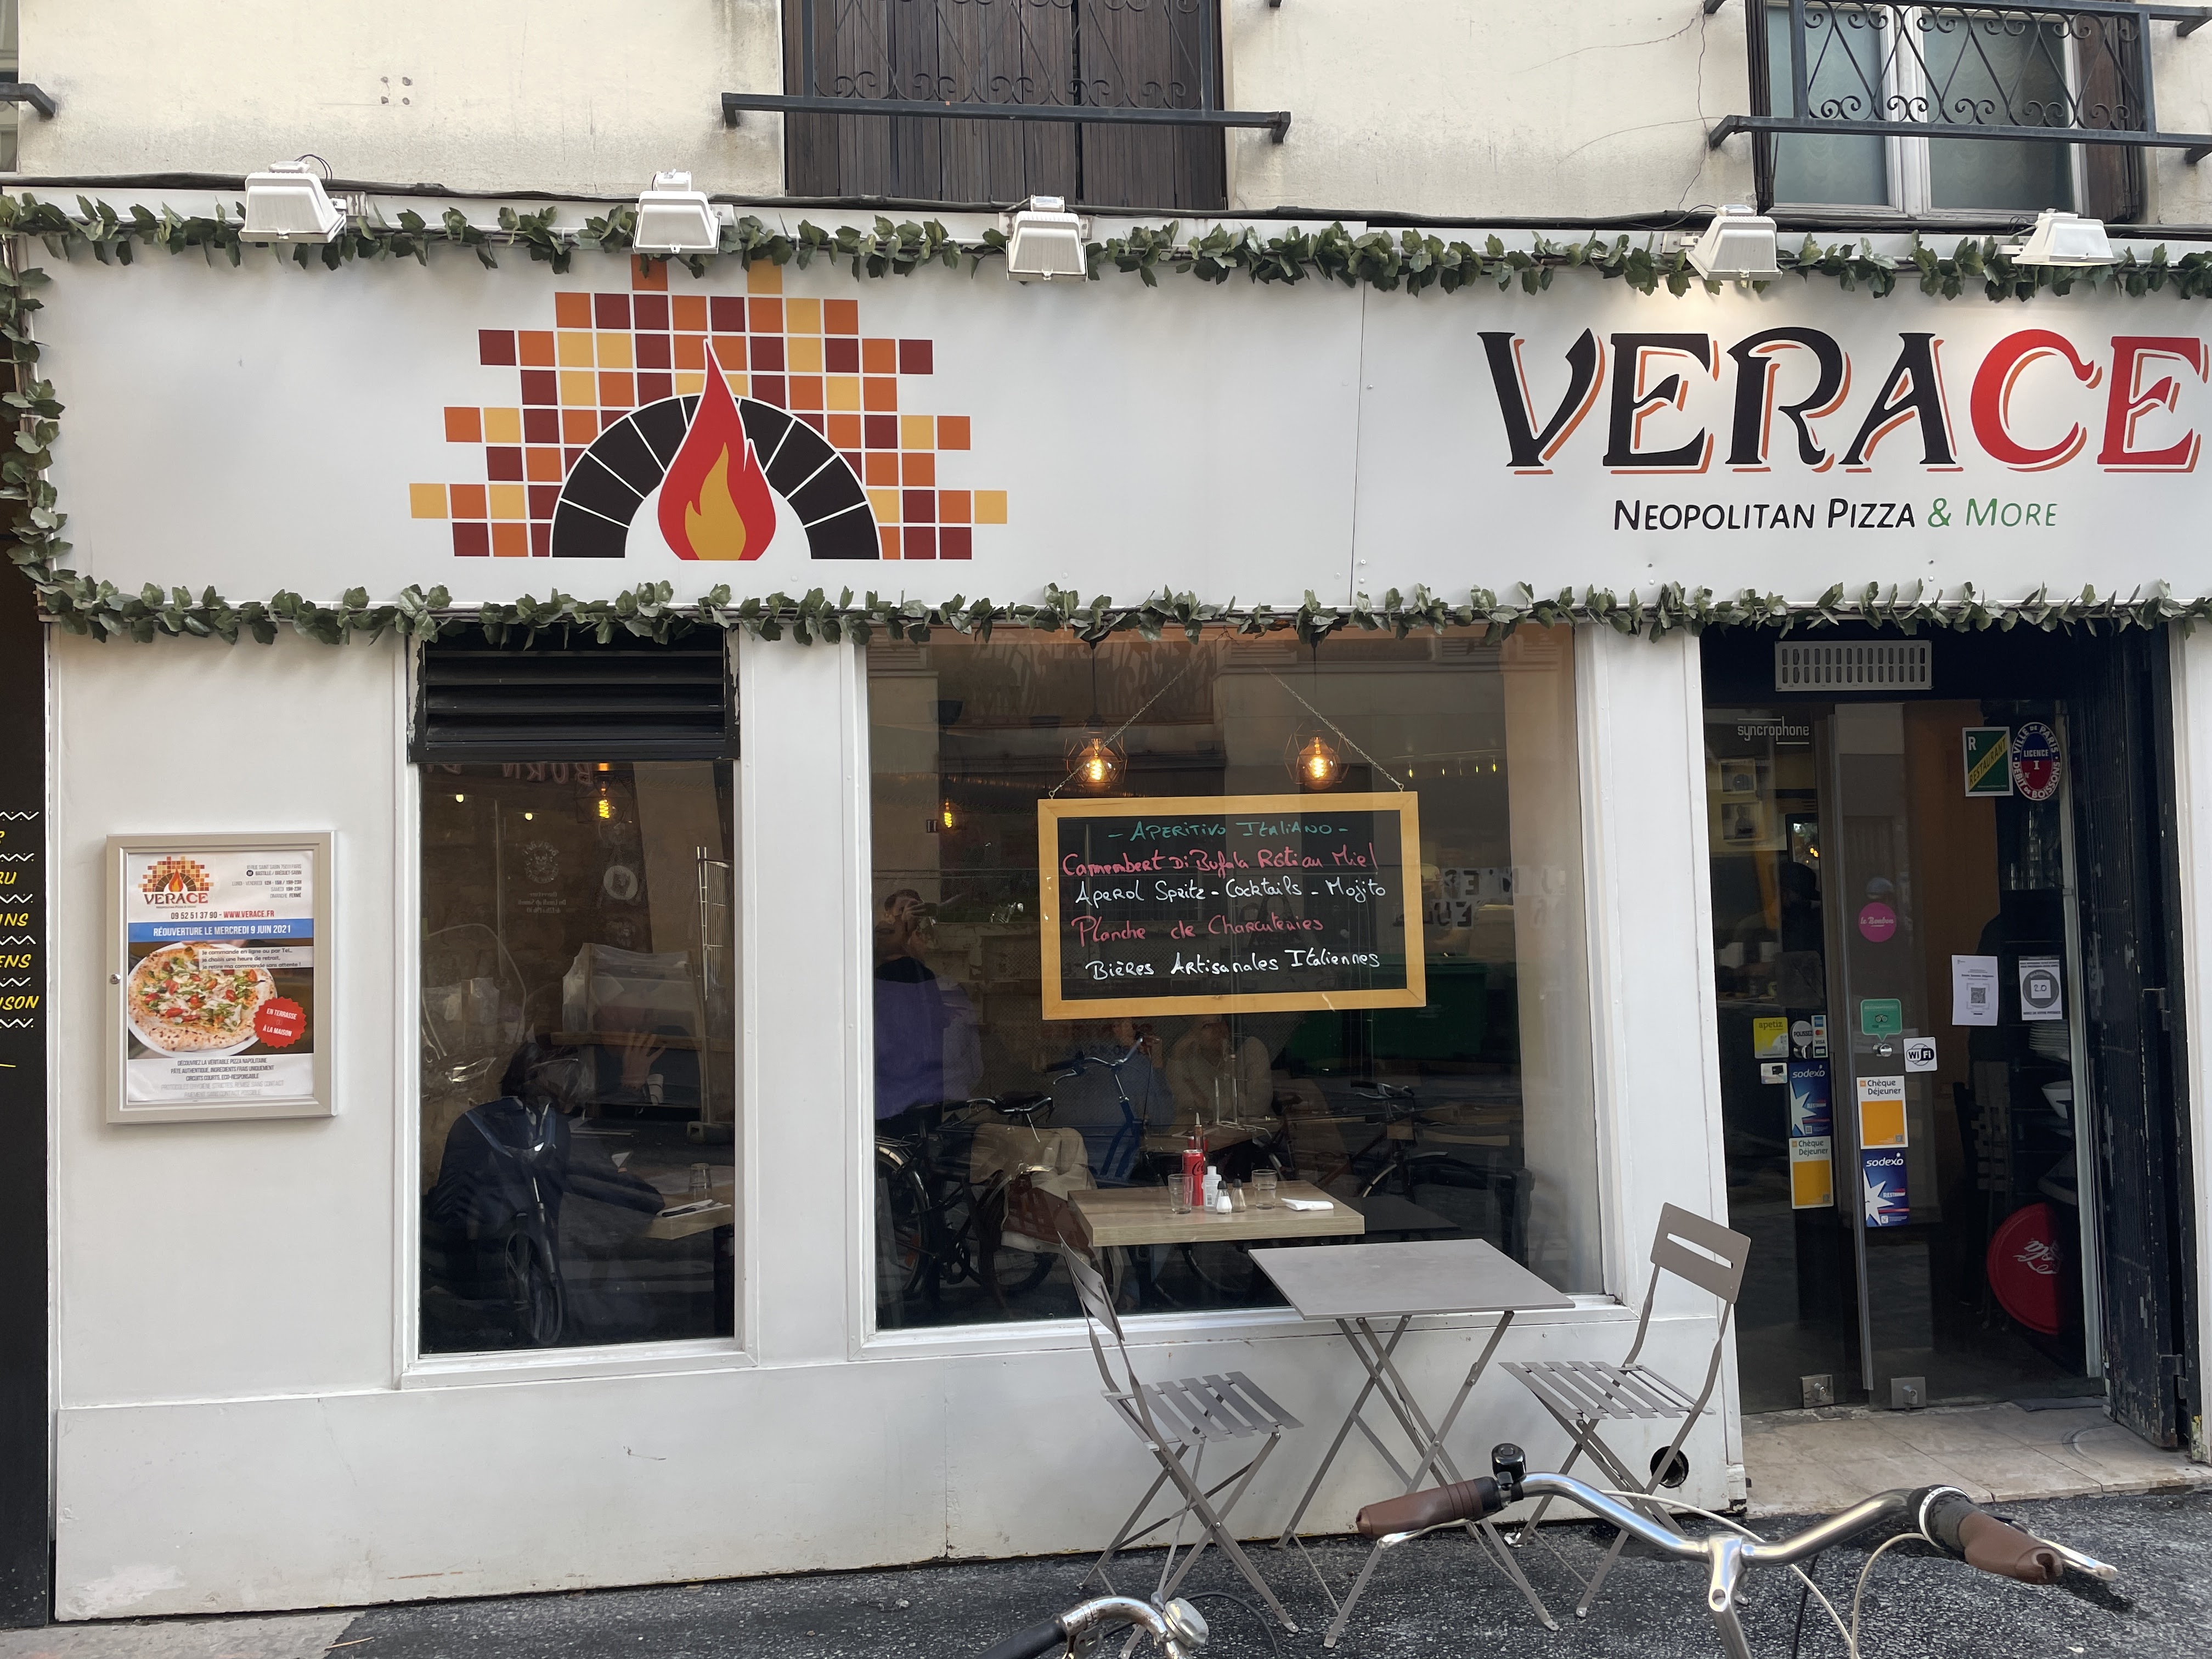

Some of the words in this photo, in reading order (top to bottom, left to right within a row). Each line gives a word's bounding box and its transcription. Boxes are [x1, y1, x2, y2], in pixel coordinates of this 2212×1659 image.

[1477, 327, 2209, 475] VERACE
[1615, 499, 1815, 531] NEOPOLITAN
[1828, 498, 1915, 529] PIZZA
[1928, 497, 1952, 528] &
[1966, 498, 2059, 527] MORE
[1737, 715, 1809, 741] syncrophone
[1968, 736, 1977, 751] R
[2013, 728, 2029, 754] VILLE
[2039, 725, 2058, 753] PARIS
[1969, 737, 2006, 786] RESTAURANT
[2012, 761, 2027, 787] DEBIT
[2032, 761, 2061, 799] BOISSONS
[1302, 856, 1323, 868] au
[1331, 842, 1379, 871] Miel
[1075, 879, 1144, 909] Aperol
[1154, 878, 1206, 903] Spritz
[1225, 875, 1302, 898] Cocktails
[1325, 876, 1386, 903] Mojito
[144, 893, 208, 905] VERACE
[223, 910, 274, 918] WWW.VERACE.FR
[153, 926, 203, 936] RÉOUVERTURE
[204, 927, 213, 935] LE
[214, 926, 249, 935] MERCREDI
[250, 926, 255, 934] 9
[256, 925, 272, 934] JUIN
[273, 924, 291, 934] 2021
[1071, 915, 1146, 947] Planche
[1170, 919, 1196, 940] de
[1207, 911, 1324, 935] Charcuteries
[1085, 960, 1154, 980] Bières
[1170, 952, 1279, 975] Artisanales
[1284, 947, 1380, 968] Italiennes
[274, 1009, 297, 1020] TERRASSE
[1758, 1020, 1784, 1030] apetiz
[273, 1028, 292, 1036] MAISON
[1792, 1066, 1825, 1078] sodexo
[1867, 1079, 1896, 1087] Chèque
[1867, 1087, 1901, 1096] Déjeuner
[1798, 1139, 1824, 1148] Chèque
[1799, 1147, 1828, 1157] Déjeuner
[1866, 1154, 1904, 1167] sodexo
